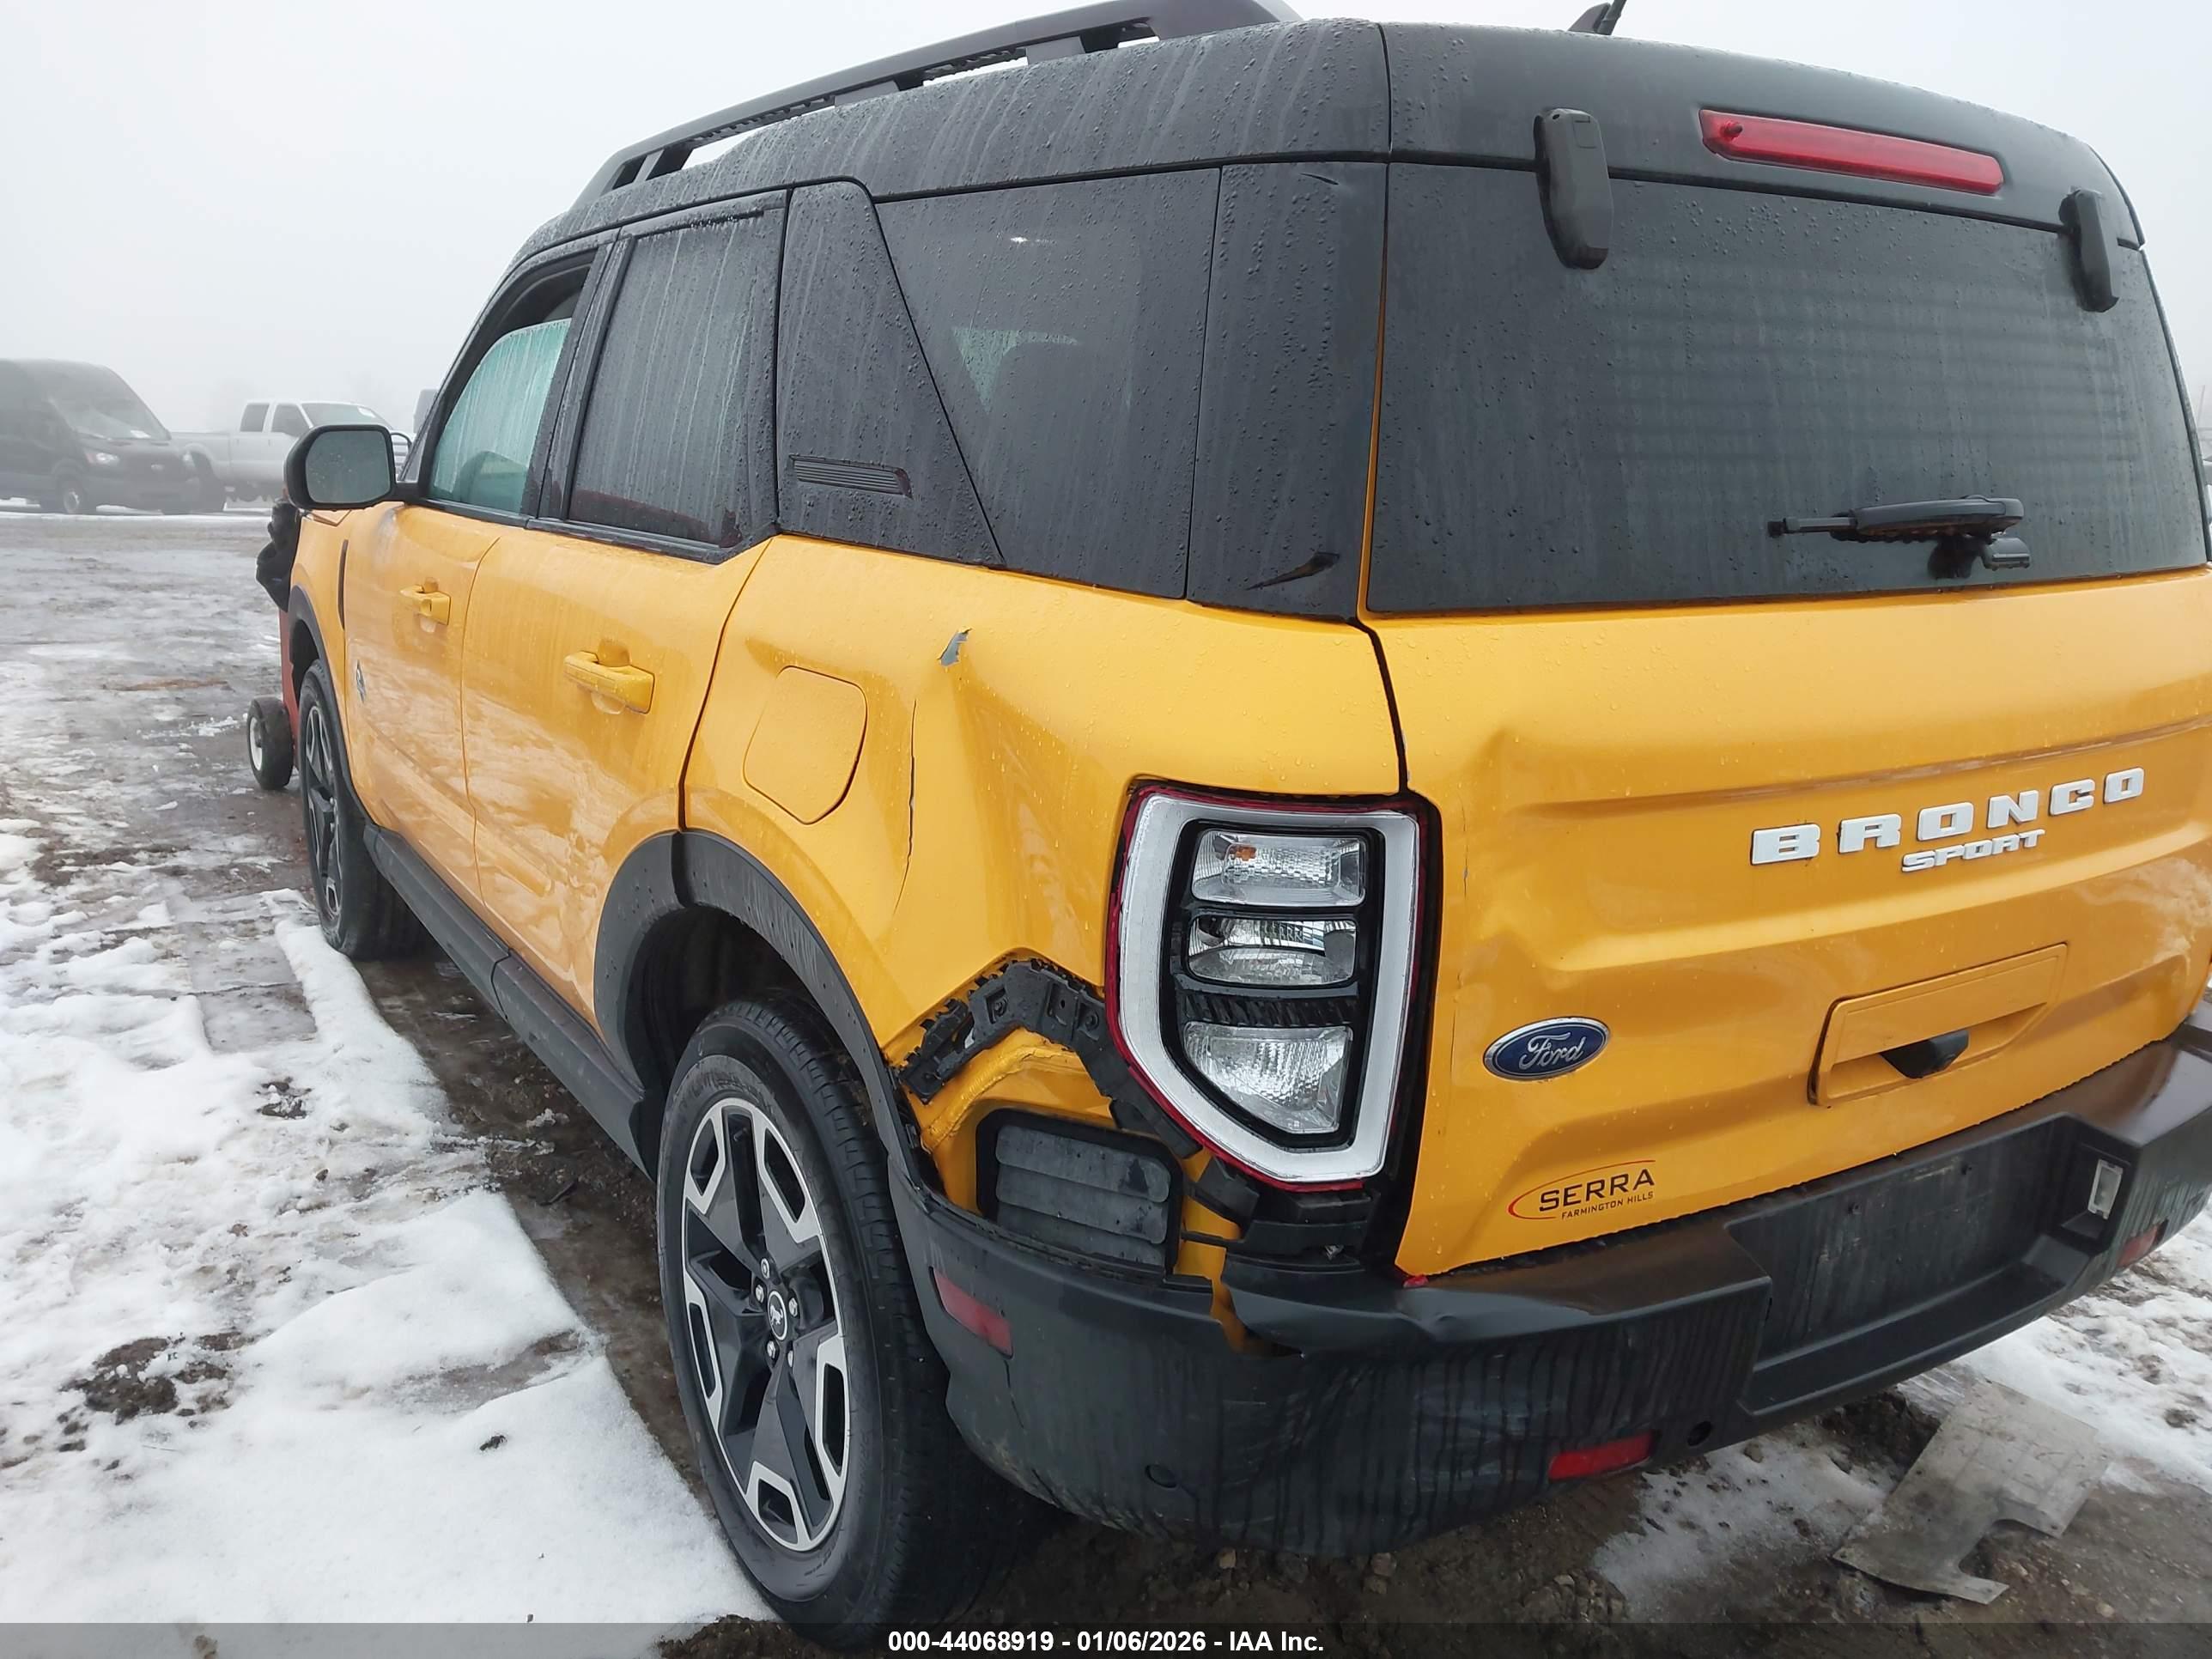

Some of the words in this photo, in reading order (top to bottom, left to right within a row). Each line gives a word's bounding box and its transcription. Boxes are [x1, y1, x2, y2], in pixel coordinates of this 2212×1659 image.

[1750, 767, 2146, 866] BRONCO
[1900, 829, 2046, 873] SPORT
[1518, 1031, 1587, 1070] Ford
[1539, 1168, 1656, 1212] SERRA
[1560, 1198, 1624, 1220] FARMINGTON
[1626, 1190, 1655, 1206] HILLS
